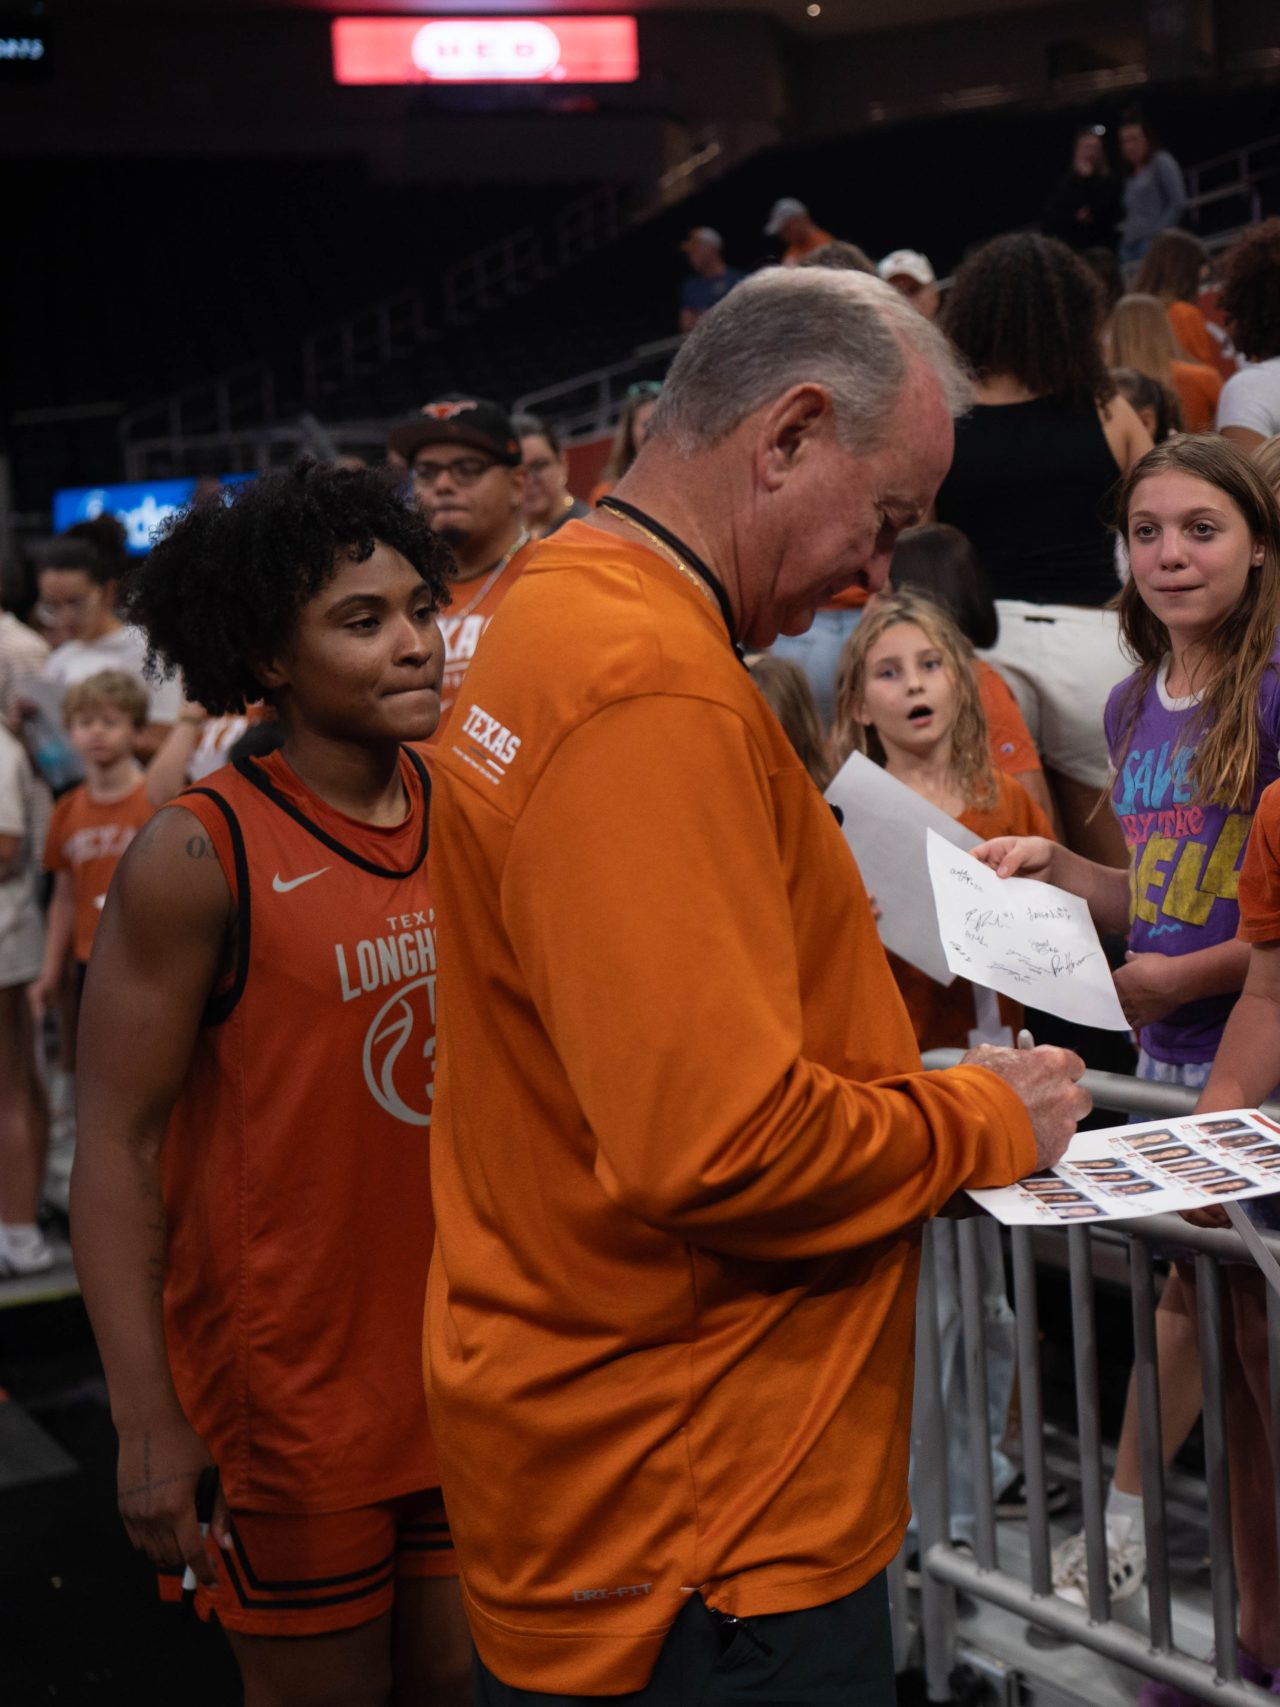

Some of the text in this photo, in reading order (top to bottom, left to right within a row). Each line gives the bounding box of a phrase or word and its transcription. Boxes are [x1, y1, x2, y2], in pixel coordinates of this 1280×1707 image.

[462, 704, 522, 765] TEXAS
[1114, 741, 1199, 817] SAVE
[1119, 811, 1157, 847] BY
[1128, 814, 1255, 927] ELL
[334, 927, 437, 1003] LONGH
[572, 1583, 653, 1602] DRI-FIT
